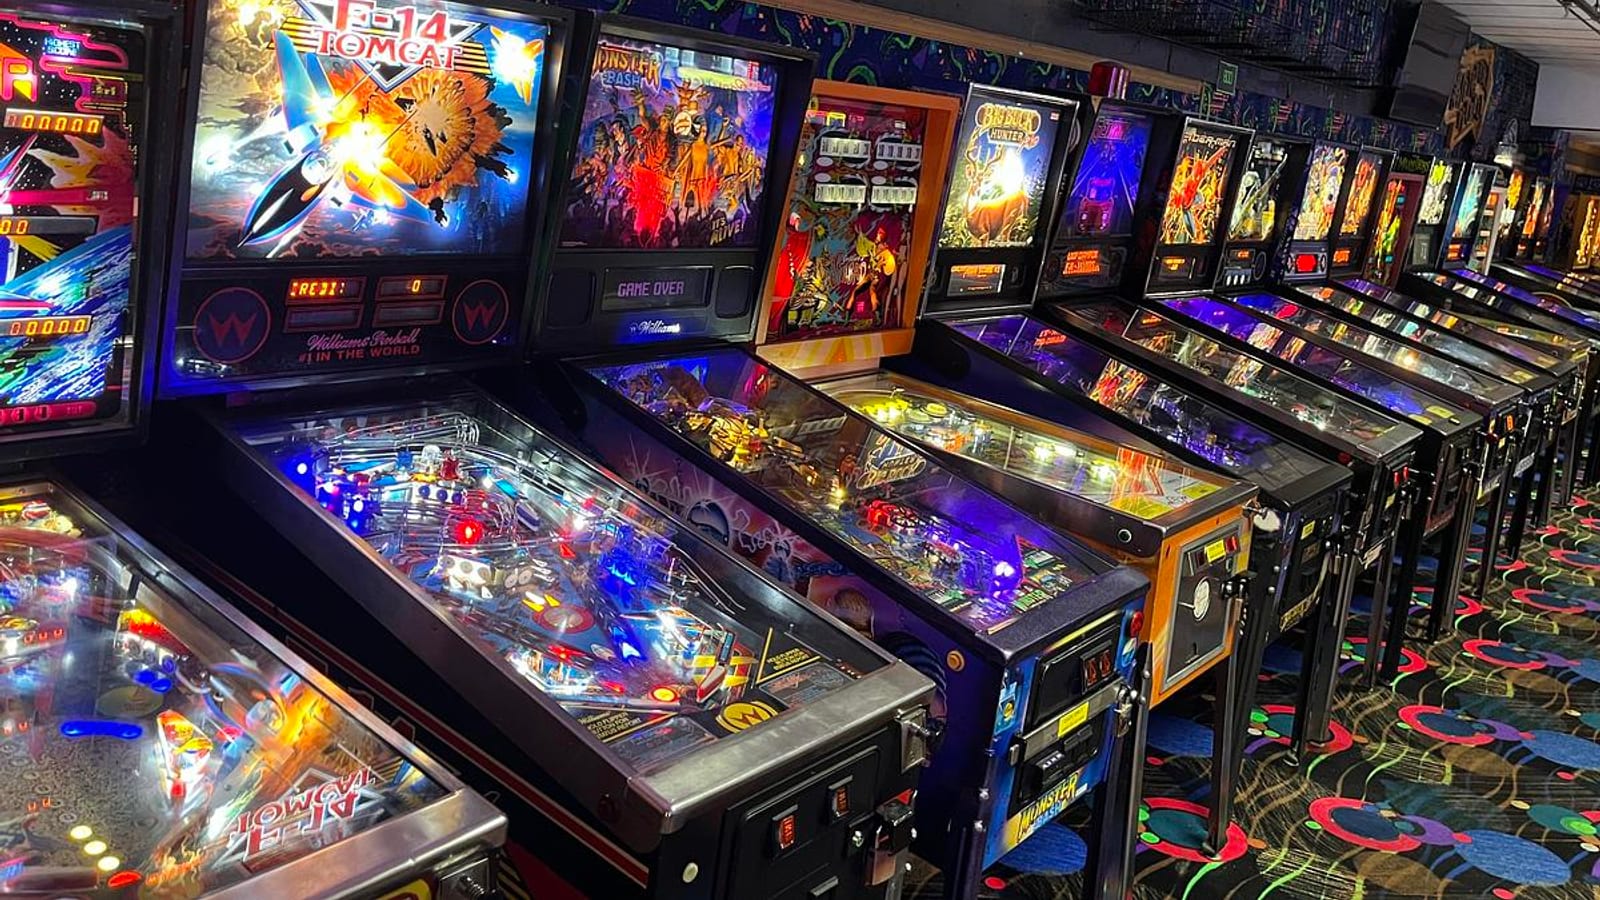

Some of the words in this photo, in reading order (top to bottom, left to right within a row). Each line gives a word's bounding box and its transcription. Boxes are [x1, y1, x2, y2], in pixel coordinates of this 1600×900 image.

[335, 0, 448, 43] F-14
[318, 30, 462, 70] TOMCAT
[605, 70, 641, 87] BASH
[984, 104, 1004, 127] BIG
[1004, 107, 1035, 135] BUCK
[991, 128, 1024, 141] HUNTER
[710, 220, 744, 246] ALIVE!
[618, 282, 649, 298] GAME
[653, 281, 685, 296] OVER
[306, 332, 370, 352] Williams
[369, 327, 422, 348] Pinball
[315, 350, 331, 362] IN
[336, 349, 365, 361] THE
[370, 344, 421, 358] WORLD
[1017, 772, 1078, 844] MONSTER
